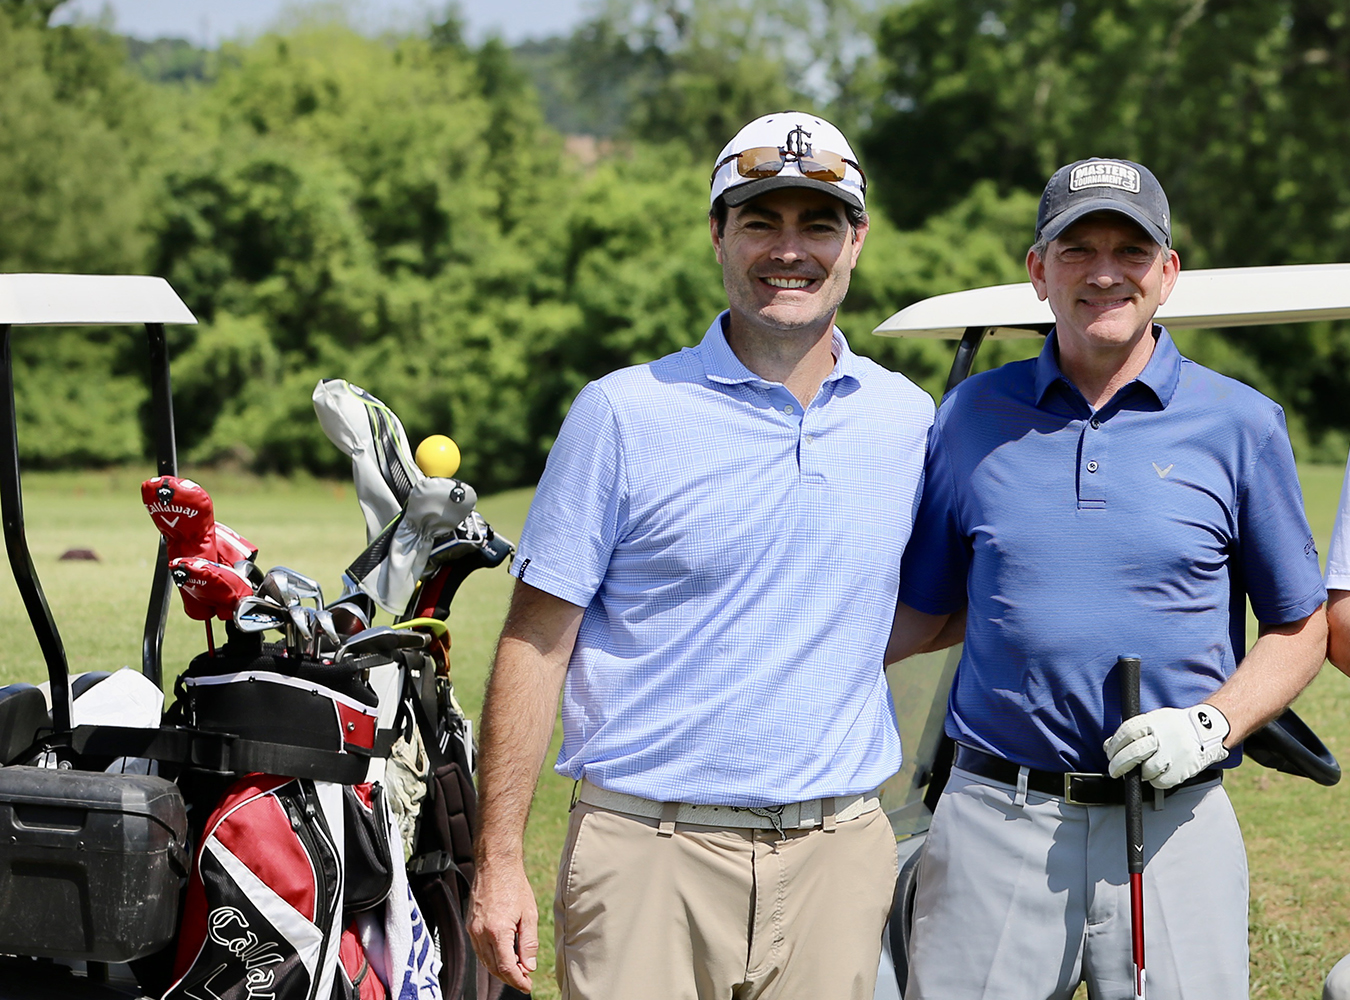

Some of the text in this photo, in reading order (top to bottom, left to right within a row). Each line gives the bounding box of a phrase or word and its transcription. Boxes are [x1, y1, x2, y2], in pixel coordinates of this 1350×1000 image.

[1074, 174, 1123, 188] TOURNAMENT
[1076, 164, 1136, 181] MASTERS
[207, 906, 285, 1000] Calla
